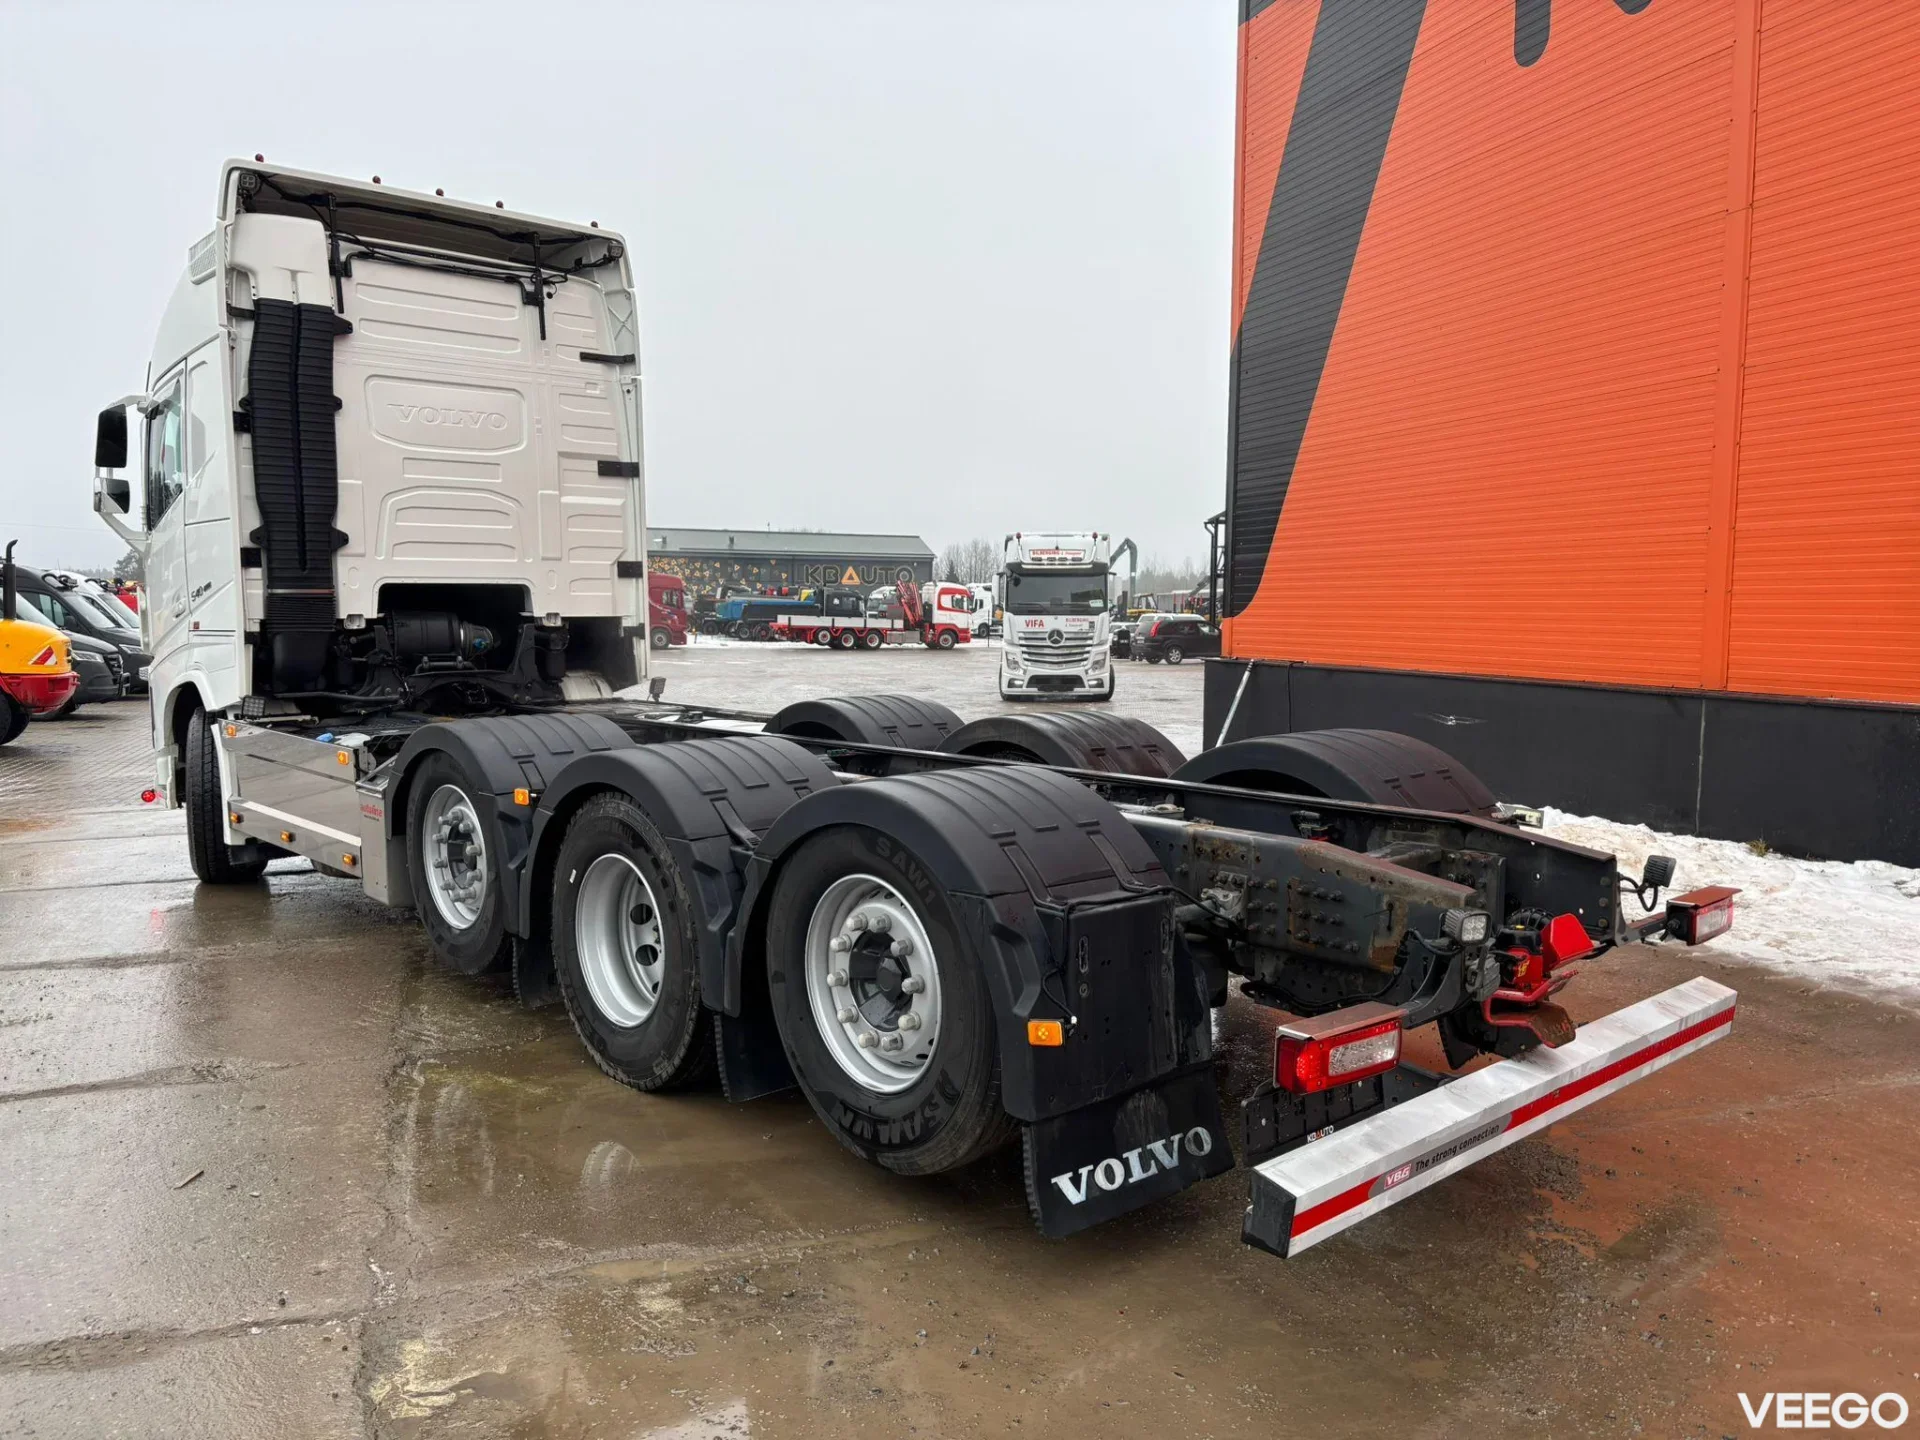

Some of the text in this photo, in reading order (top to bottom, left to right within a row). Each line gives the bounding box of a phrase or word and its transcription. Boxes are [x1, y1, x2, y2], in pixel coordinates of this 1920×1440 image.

[386, 403, 507, 431] VOLVO
[1025, 619, 1045, 628] VIFA
[1307, 1125, 1334, 1144] KBAUTO
[1051, 1126, 1212, 1206] VOLVO
[1386, 1124, 1500, 1187] VBG The strong connection
